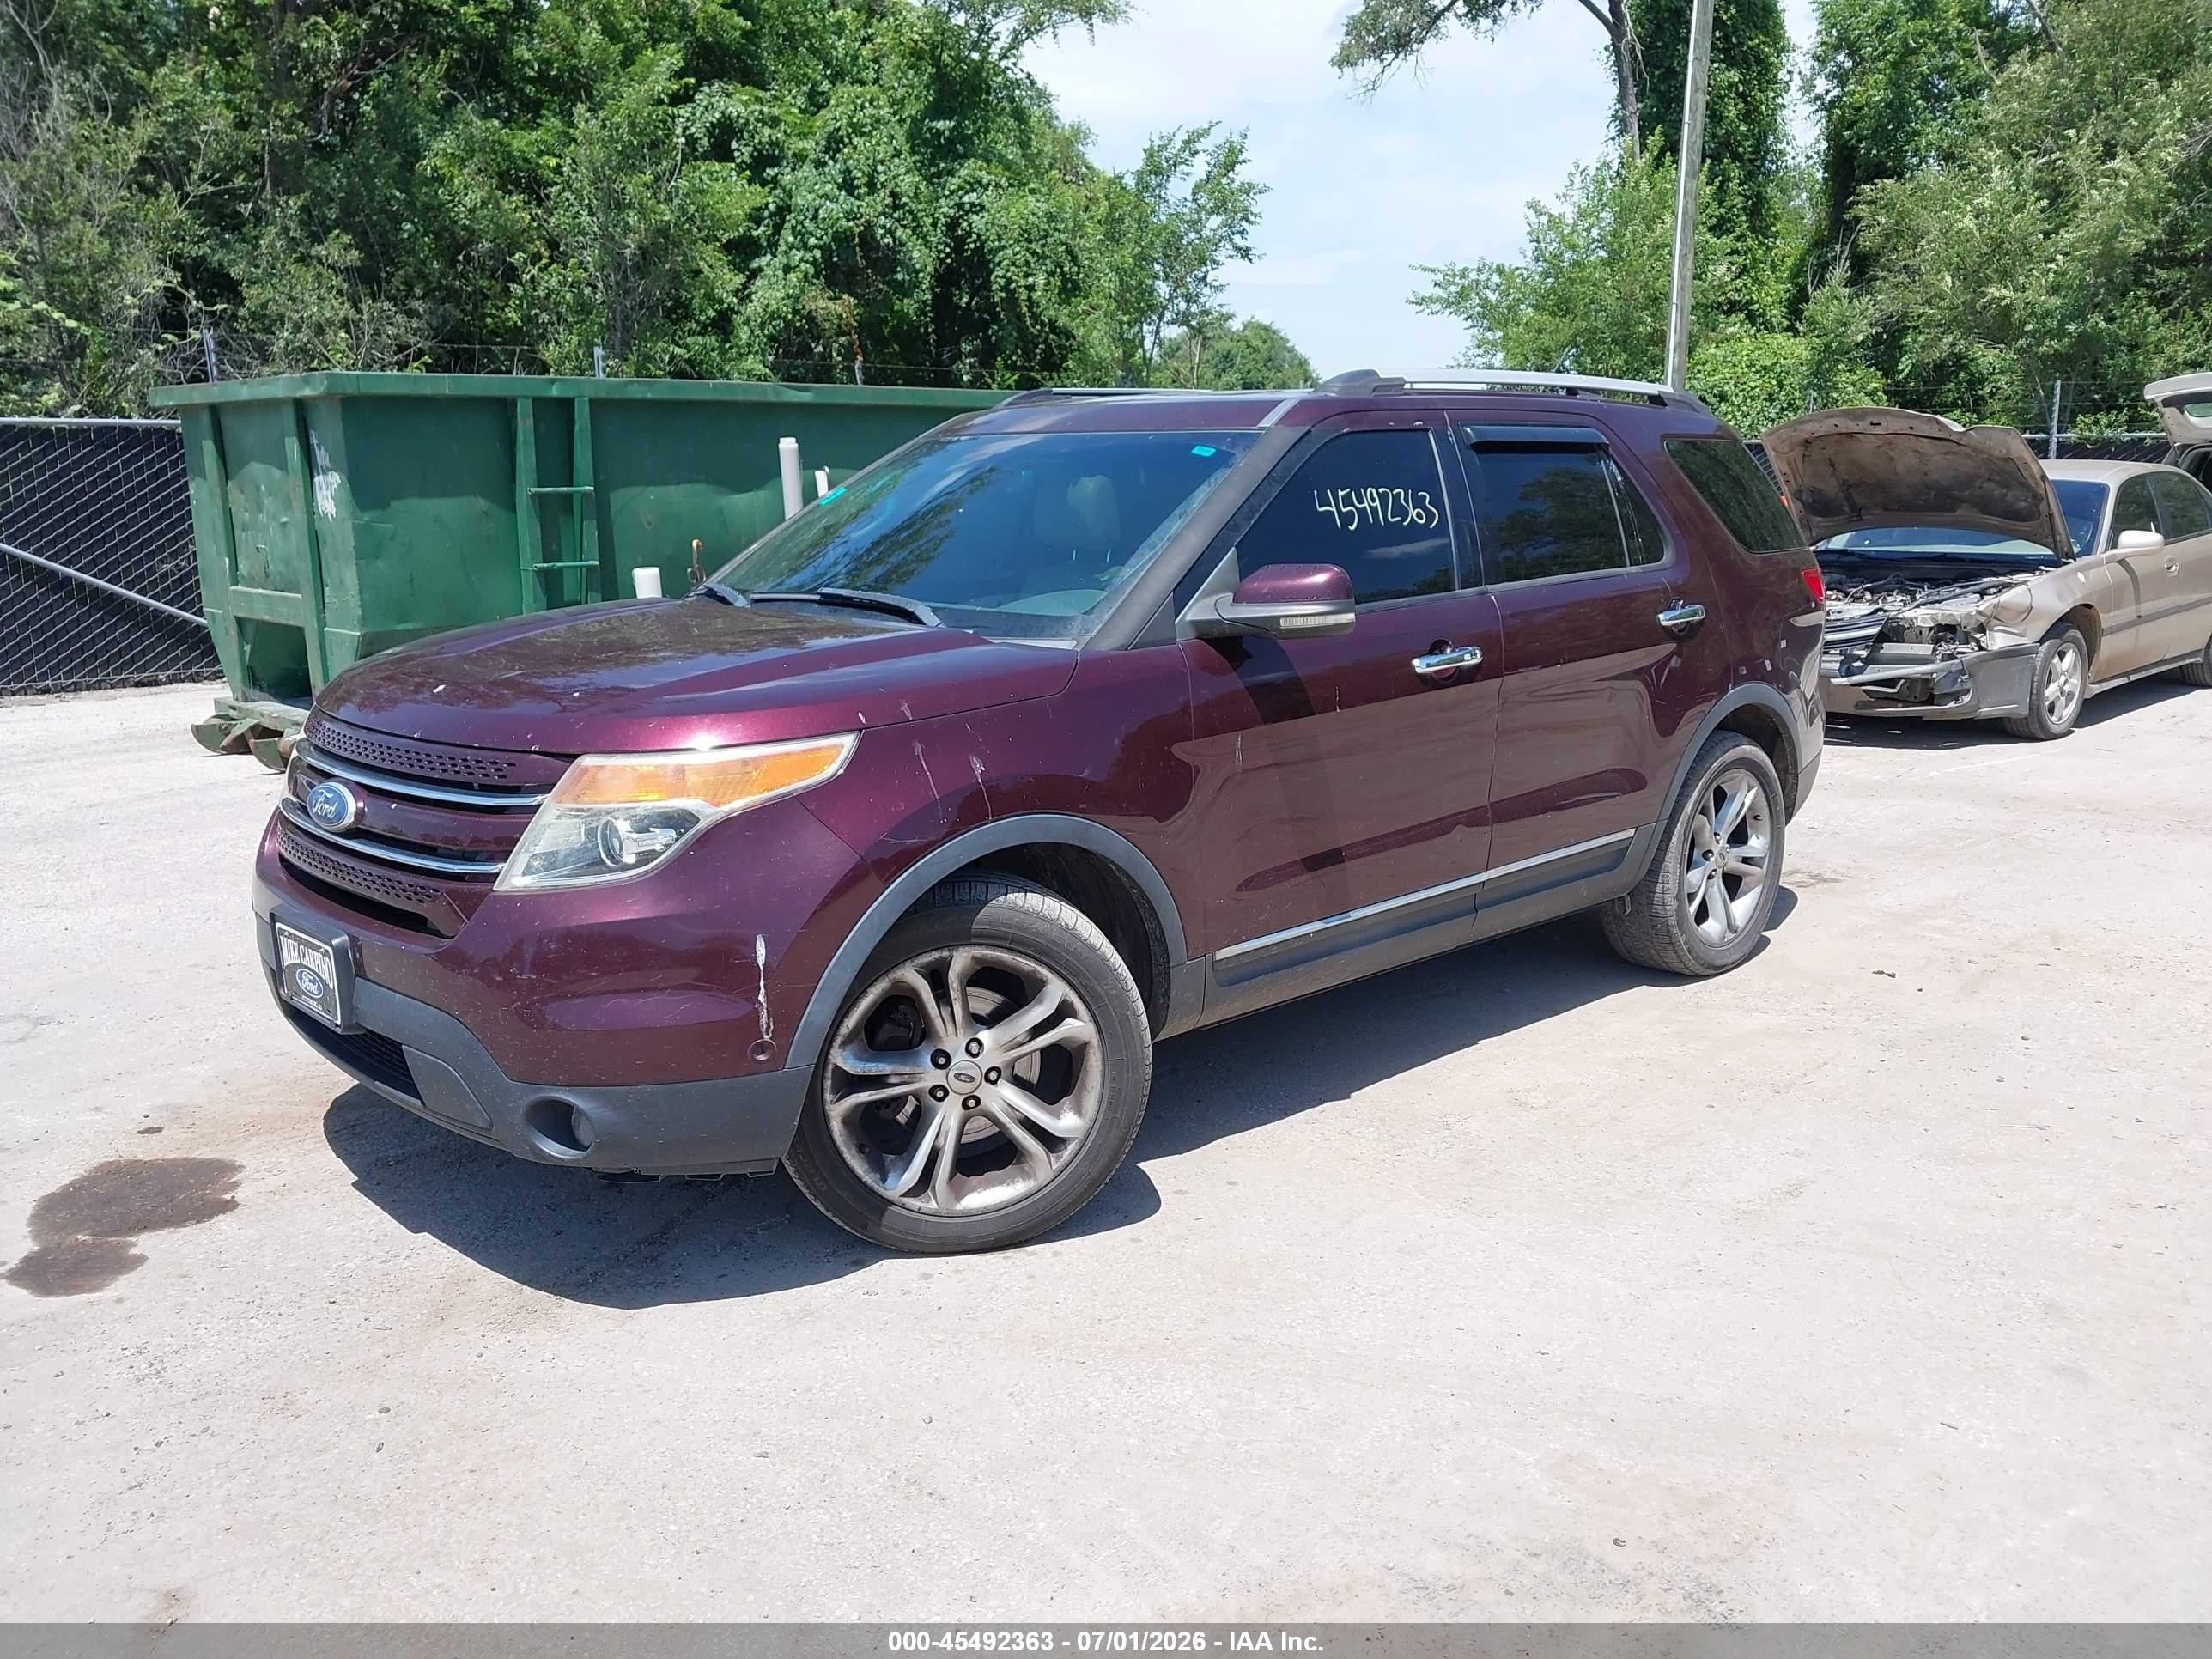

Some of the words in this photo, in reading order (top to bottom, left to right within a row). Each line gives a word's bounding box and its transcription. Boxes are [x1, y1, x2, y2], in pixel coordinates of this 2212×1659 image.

[1313, 486, 1439, 531] 45492363
[311, 788, 340, 819] Ford
[279, 935, 301, 966] MIKE
[301, 970, 319, 995] Ford
